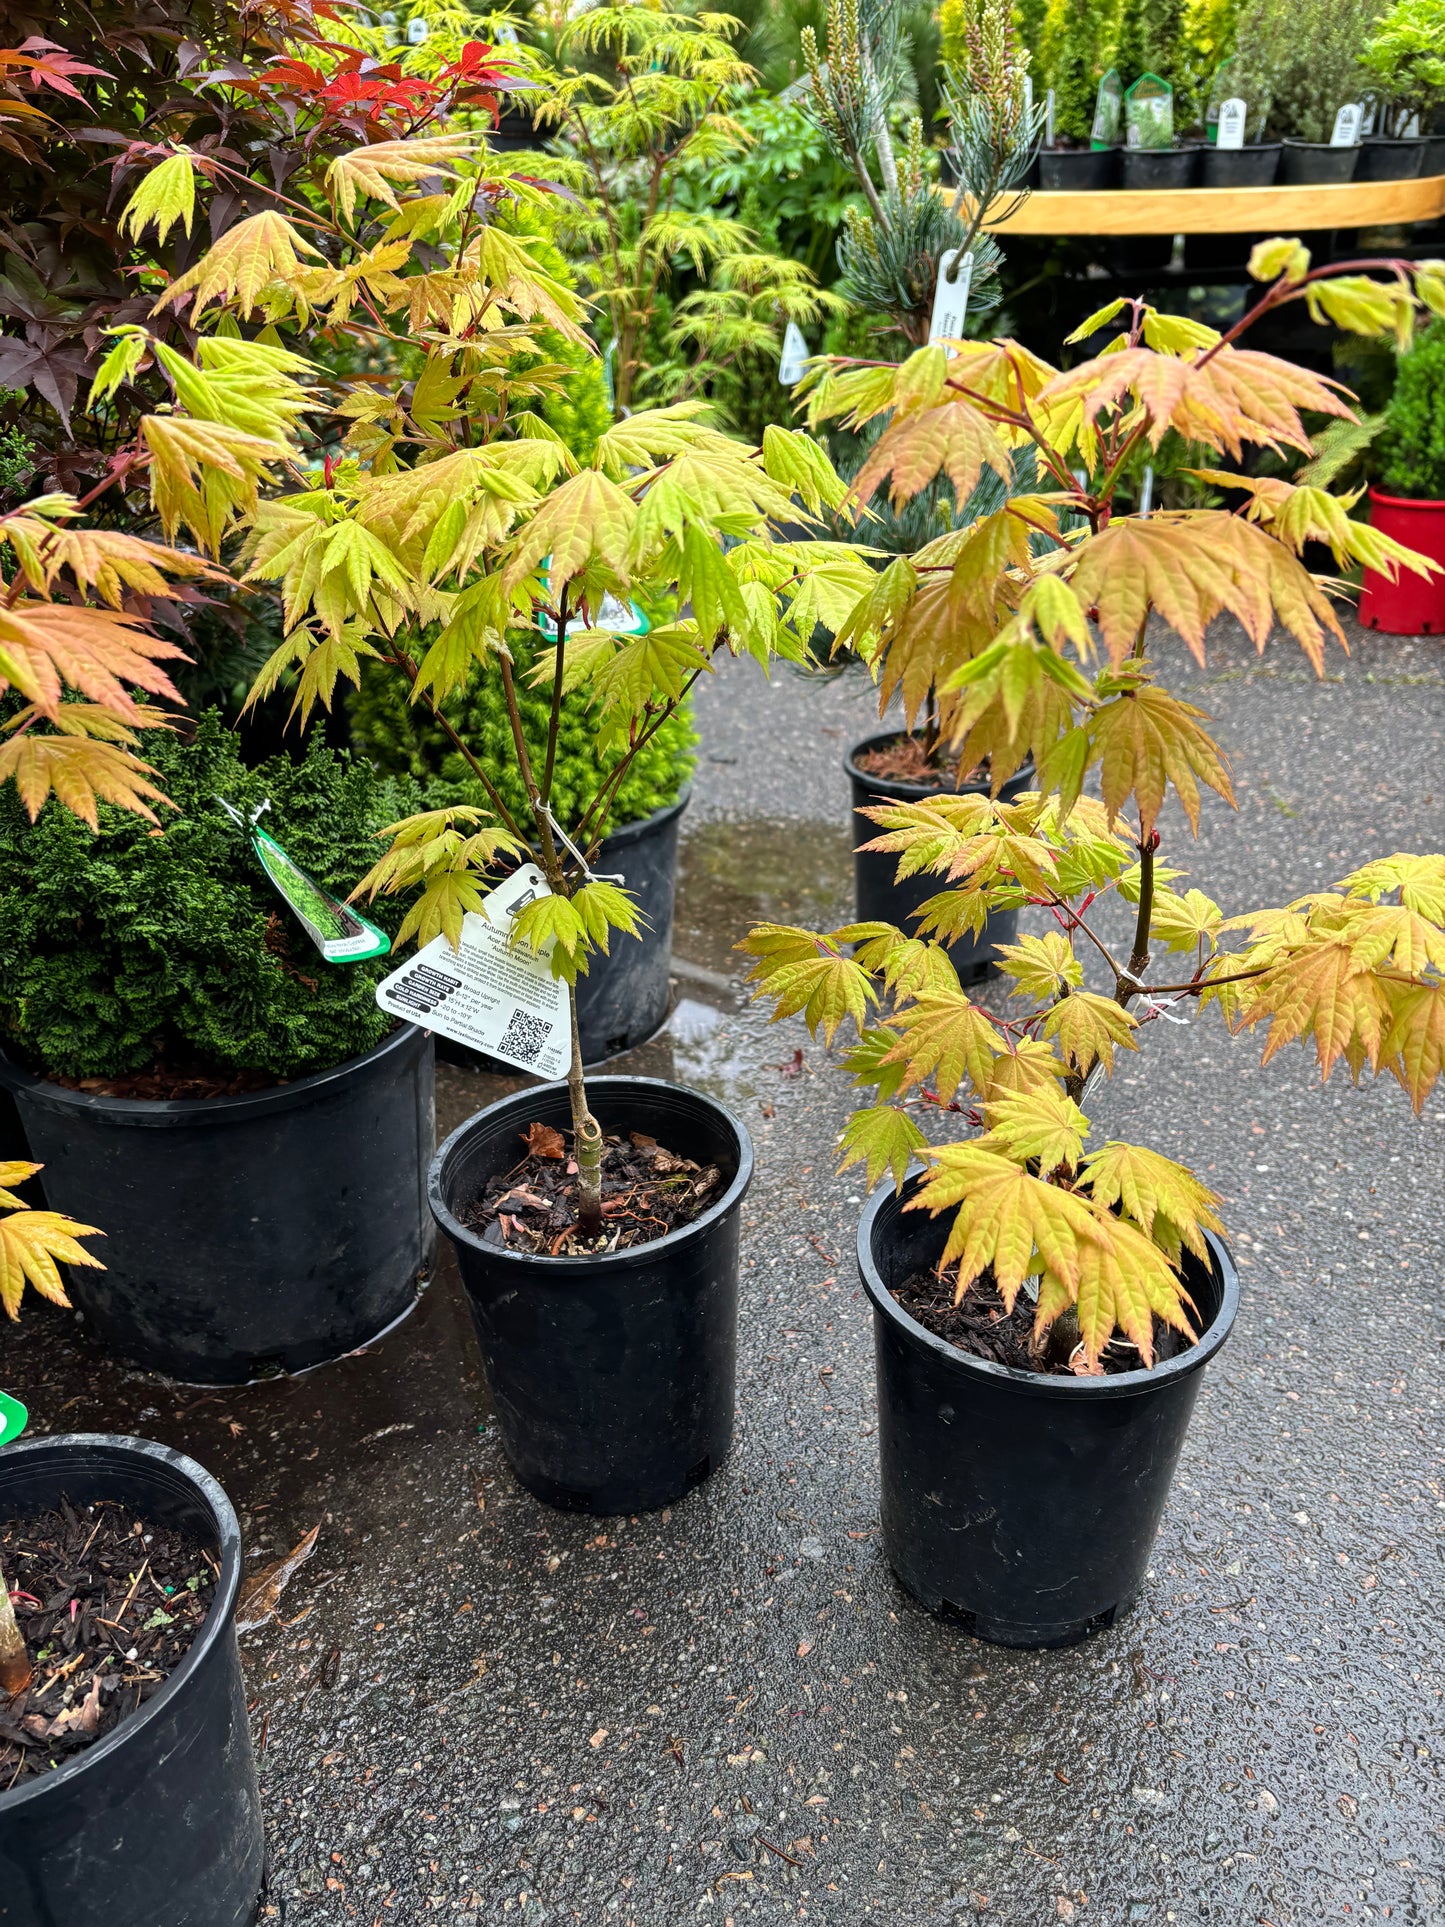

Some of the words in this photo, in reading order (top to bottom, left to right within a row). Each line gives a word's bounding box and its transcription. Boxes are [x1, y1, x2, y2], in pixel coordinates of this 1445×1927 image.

[480, 921, 510, 938] Autumn
[508, 934, 529, 948] Mon
[486, 934, 501, 945] Acer
[500, 941, 539, 962] ssawanm
[413, 972, 436, 986] GROWTH
[436, 982, 450, 992] RATE
[420, 965, 443, 979] GROWTH
[442, 975, 459, 986] HABIT
[394, 983, 409, 993] COLD
[409, 990, 437, 1006] HARDINESS
[407, 979, 429, 992] GARDEN
[428, 988, 440, 997] SIZE
[462, 984, 481, 996] Broad
[479, 991, 500, 1005] Upright
[387, 1000, 406, 1012] Product
[410, 1010, 421, 1018] USA
[395, 993, 421, 1008] SUNLIGHT
[439, 1003, 450, 1011] -20
[470, 998, 480, 1006] per
[480, 1003, 493, 1012] year
[431, 1009, 443, 1018] Sun
[449, 1017, 467, 1029] Partial
[466, 1024, 485, 1036] Shade
